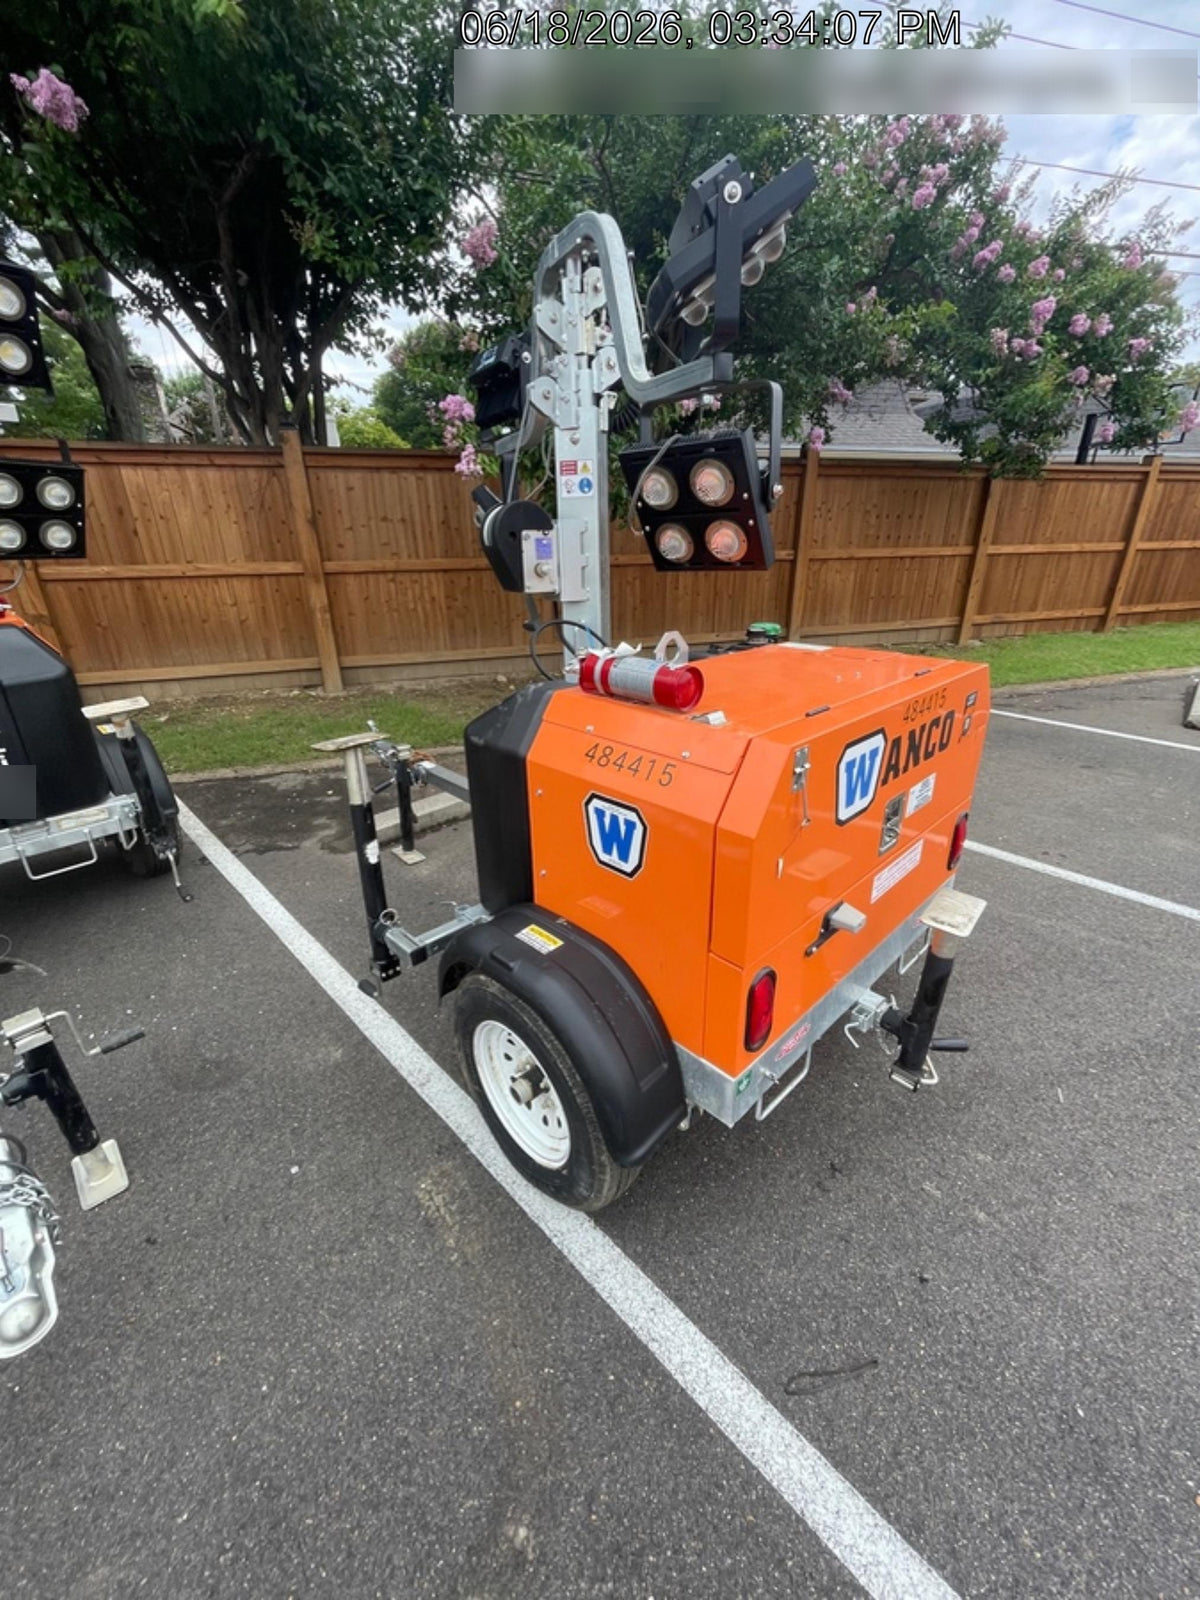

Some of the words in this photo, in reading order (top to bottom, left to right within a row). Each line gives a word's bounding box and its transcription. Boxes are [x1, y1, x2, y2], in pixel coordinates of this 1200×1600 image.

[903, 687, 948, 722] 484415
[584, 742, 677, 787] 484415
[593, 806, 637, 865] W
